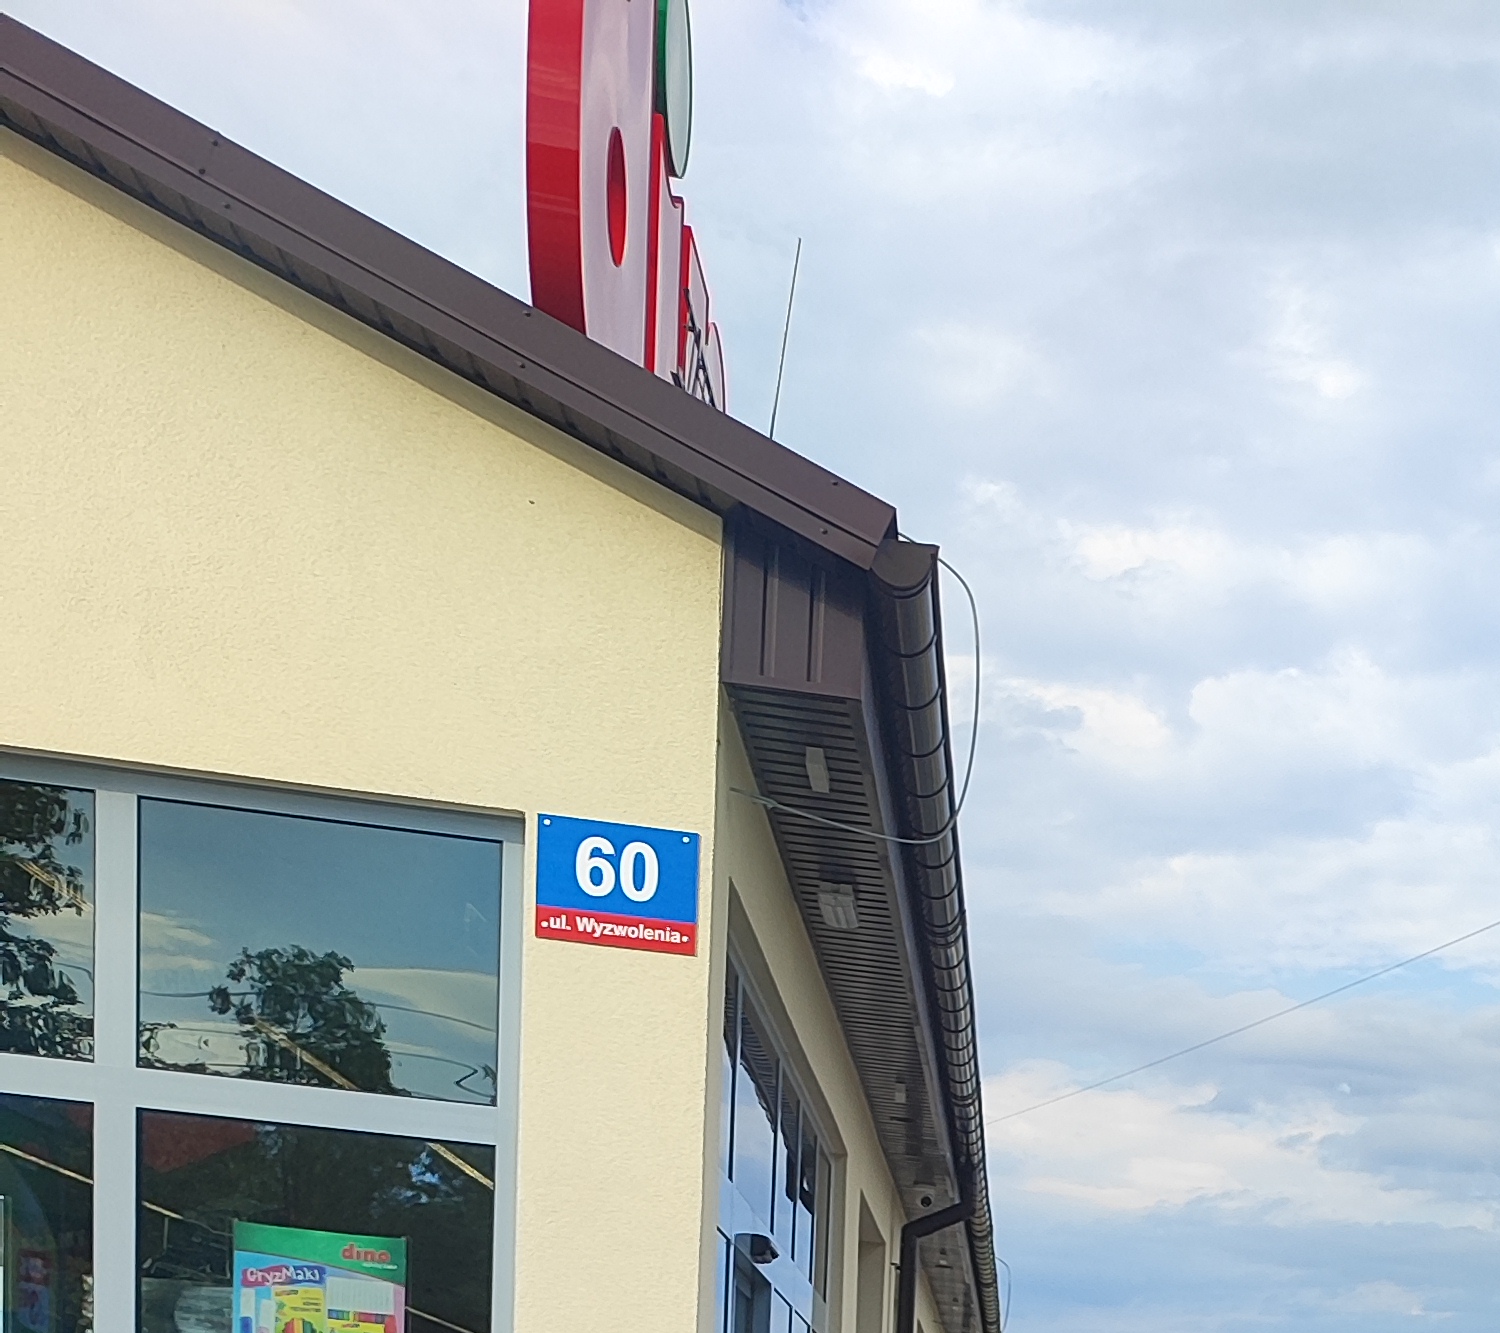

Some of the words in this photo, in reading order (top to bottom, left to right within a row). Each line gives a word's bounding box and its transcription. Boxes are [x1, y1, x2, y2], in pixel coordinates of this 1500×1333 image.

[575, 836, 660, 902] 60
[549, 914, 572, 931] ul.
[575, 916, 682, 944] Wyzwolenia
[341, 1243, 391, 1263] dino
